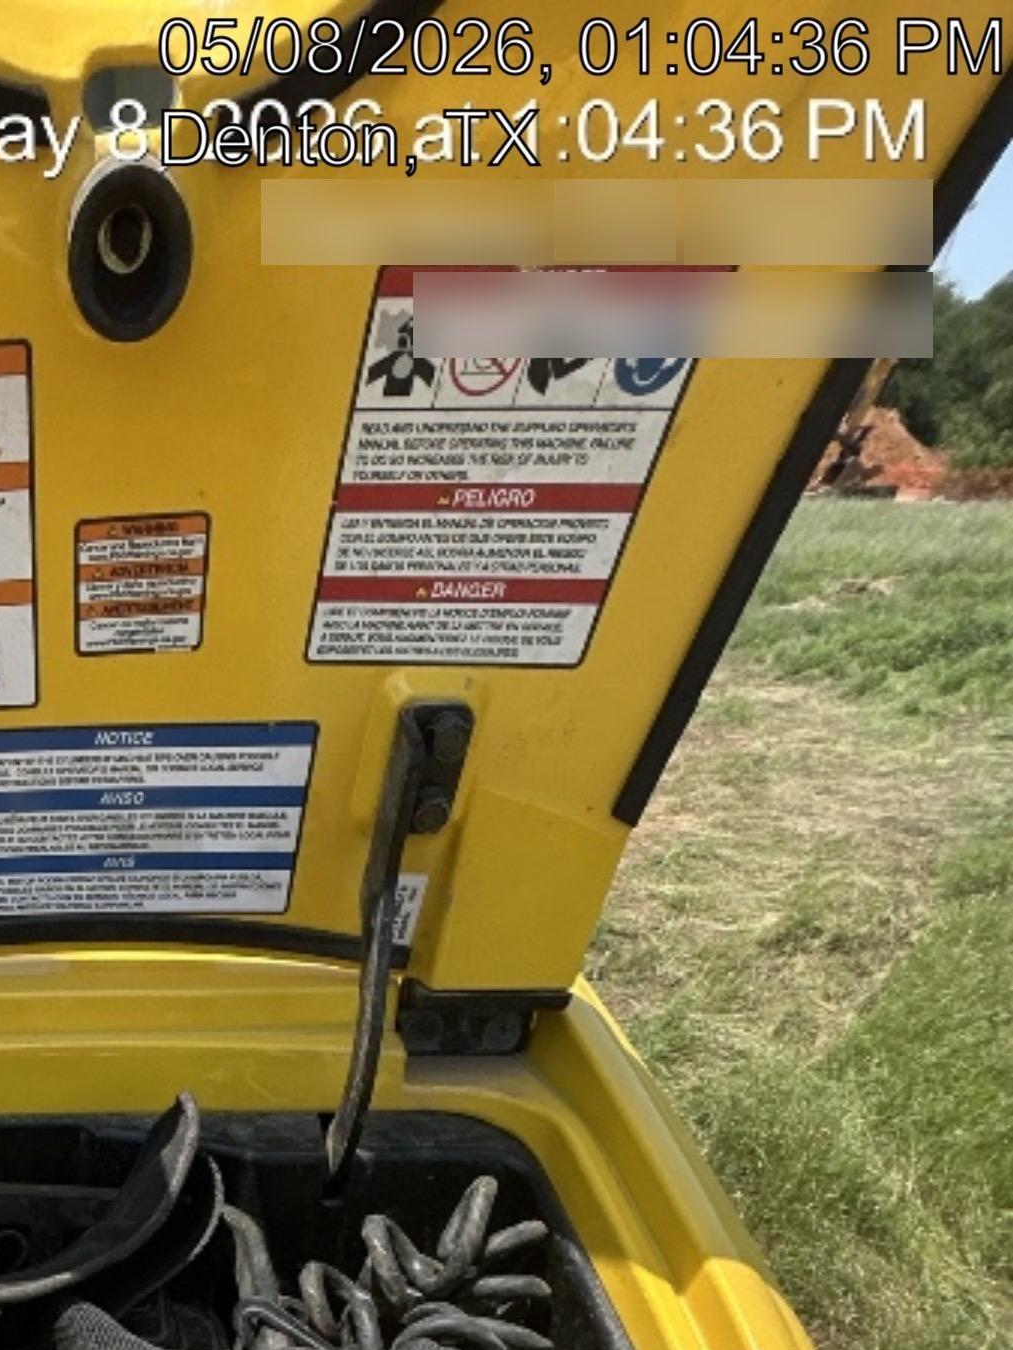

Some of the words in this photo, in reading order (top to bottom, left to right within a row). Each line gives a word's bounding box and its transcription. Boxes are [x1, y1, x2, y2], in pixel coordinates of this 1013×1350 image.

[452, 488, 536, 507] PELIGRO
[430, 582, 507, 598] DANGER
[94, 731, 155, 745] NOTICE
[99, 792, 145, 805] AVISO
